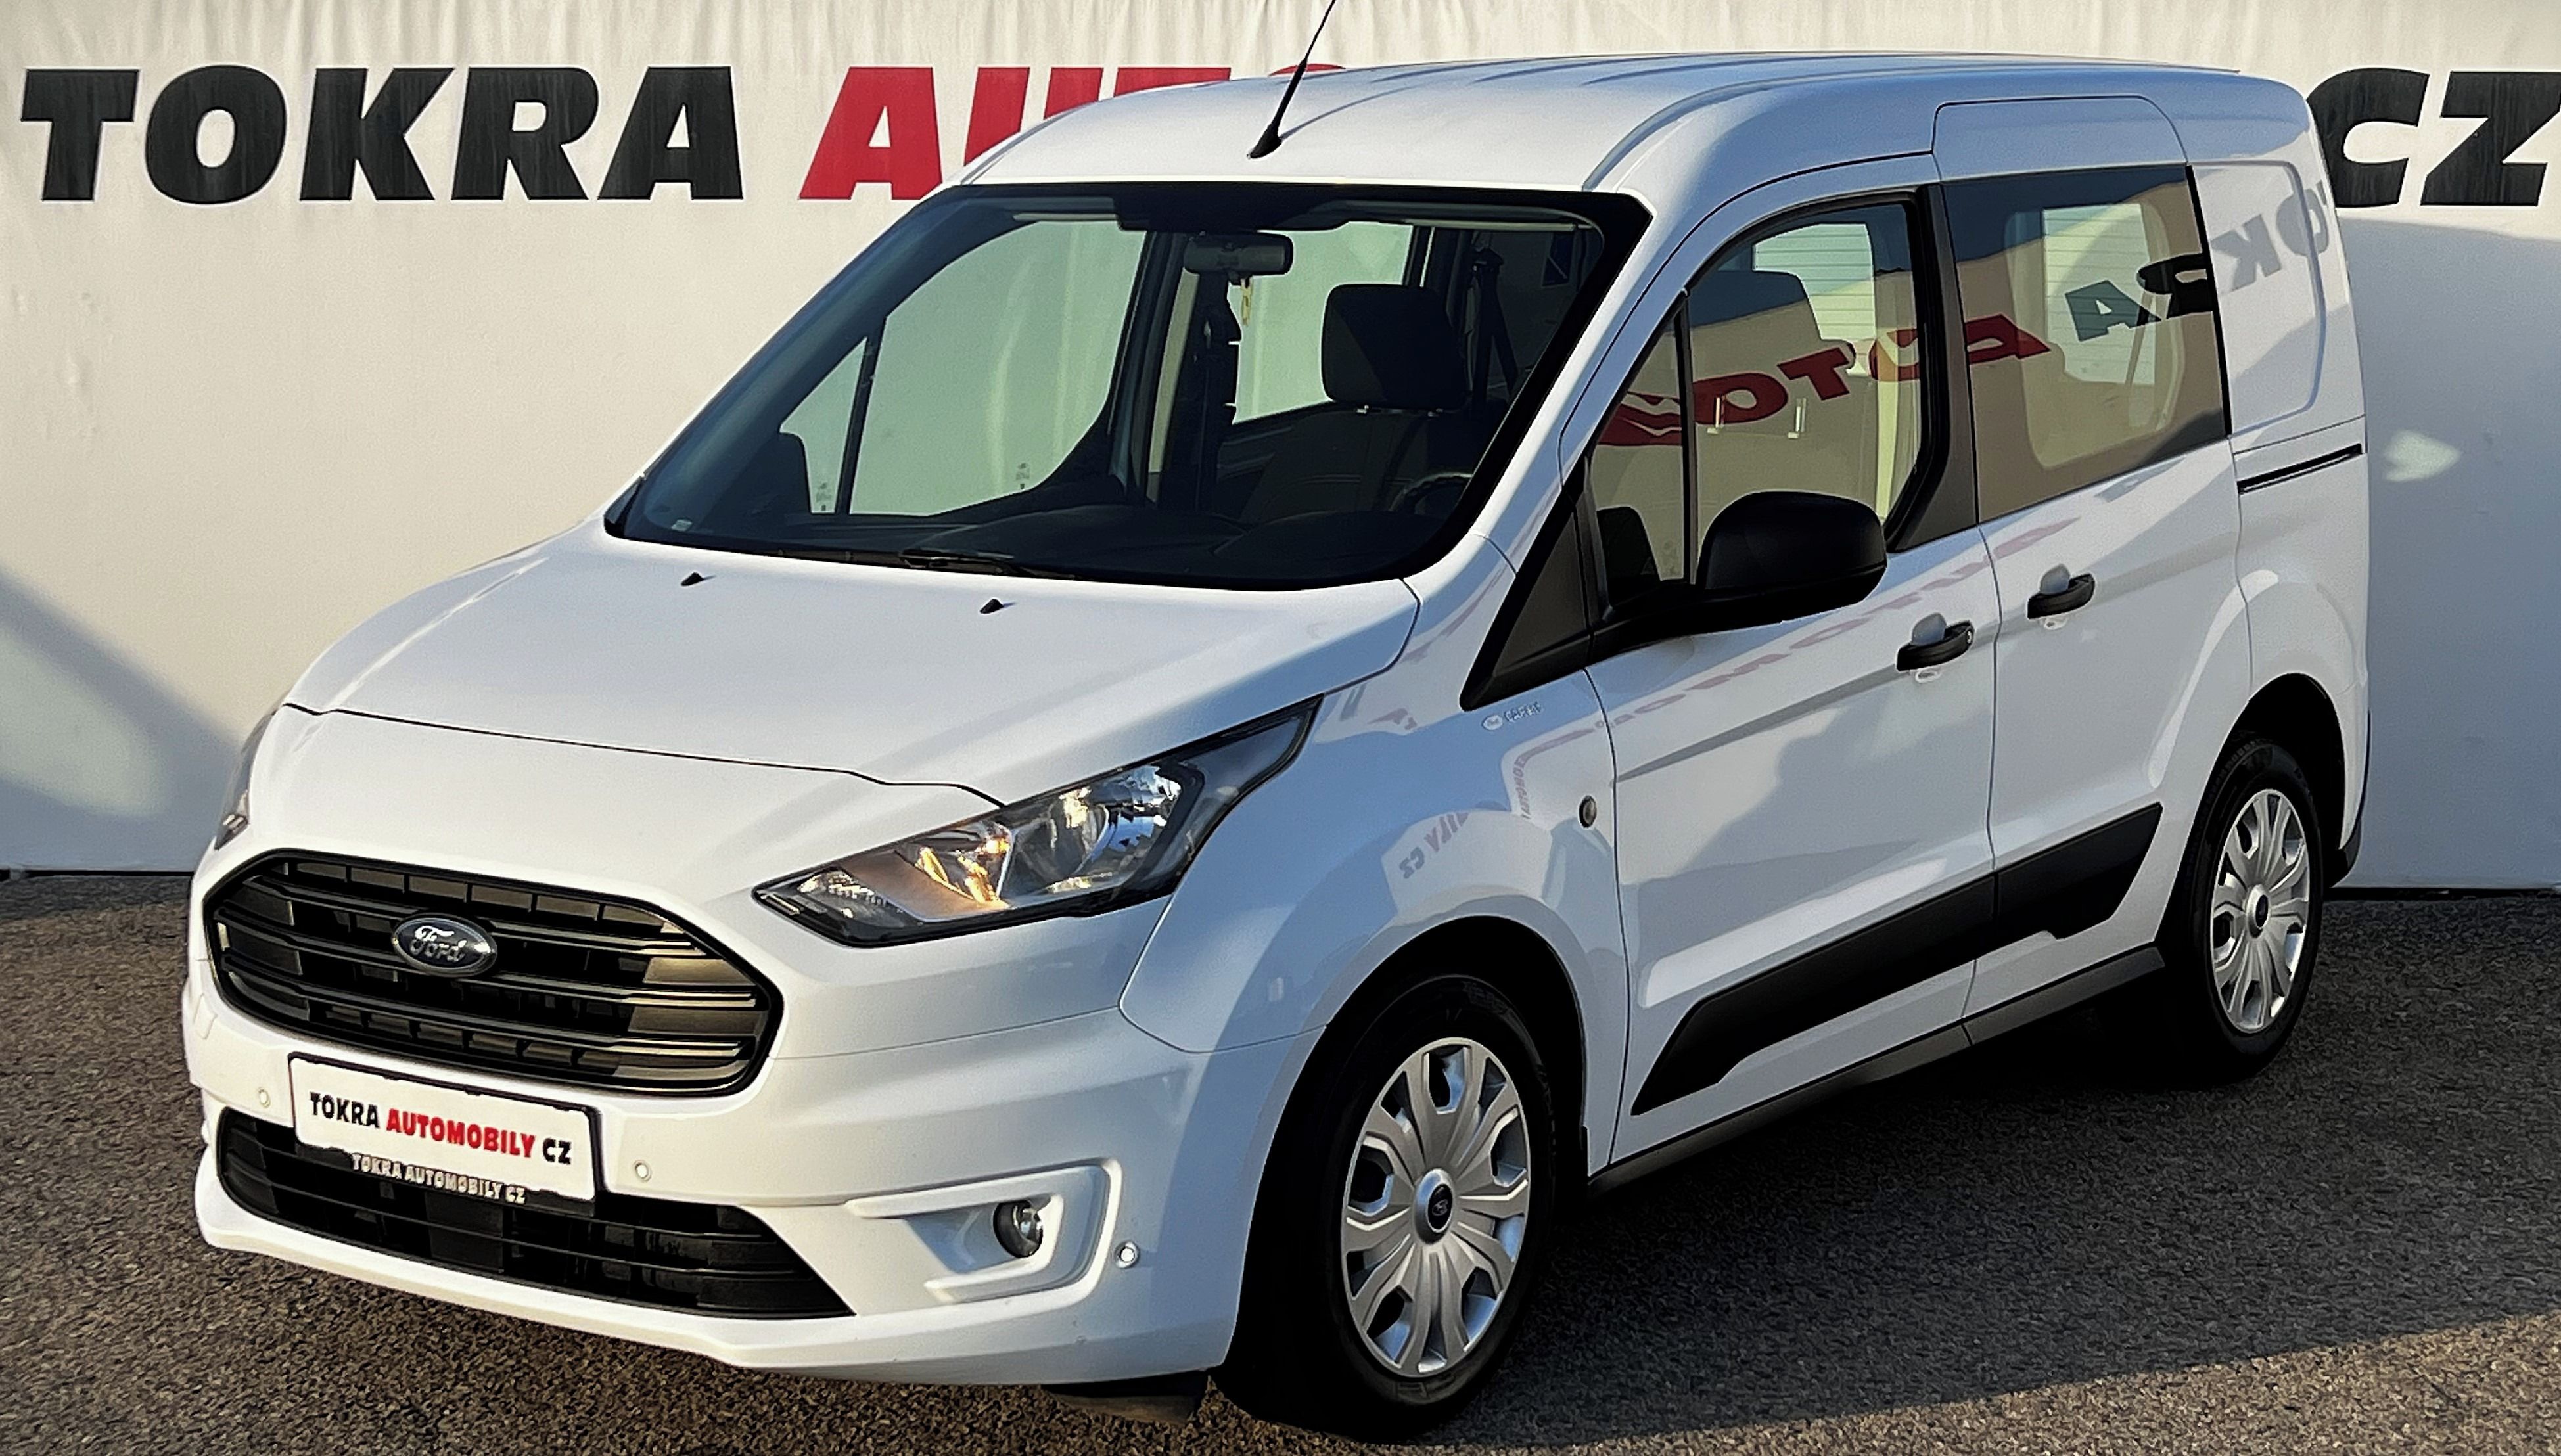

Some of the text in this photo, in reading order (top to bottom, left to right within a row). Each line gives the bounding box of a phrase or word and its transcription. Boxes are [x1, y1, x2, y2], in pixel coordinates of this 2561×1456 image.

[20, 64, 744, 204] TOKRA
[2306, 67, 2561, 208] CZ
[410, 925, 468, 962] Ford
[310, 1091, 572, 1165] TOKRA AUTOMOBILY CZ
[350, 1153, 526, 1204] TOKRA AUTOMOBILY CZ
